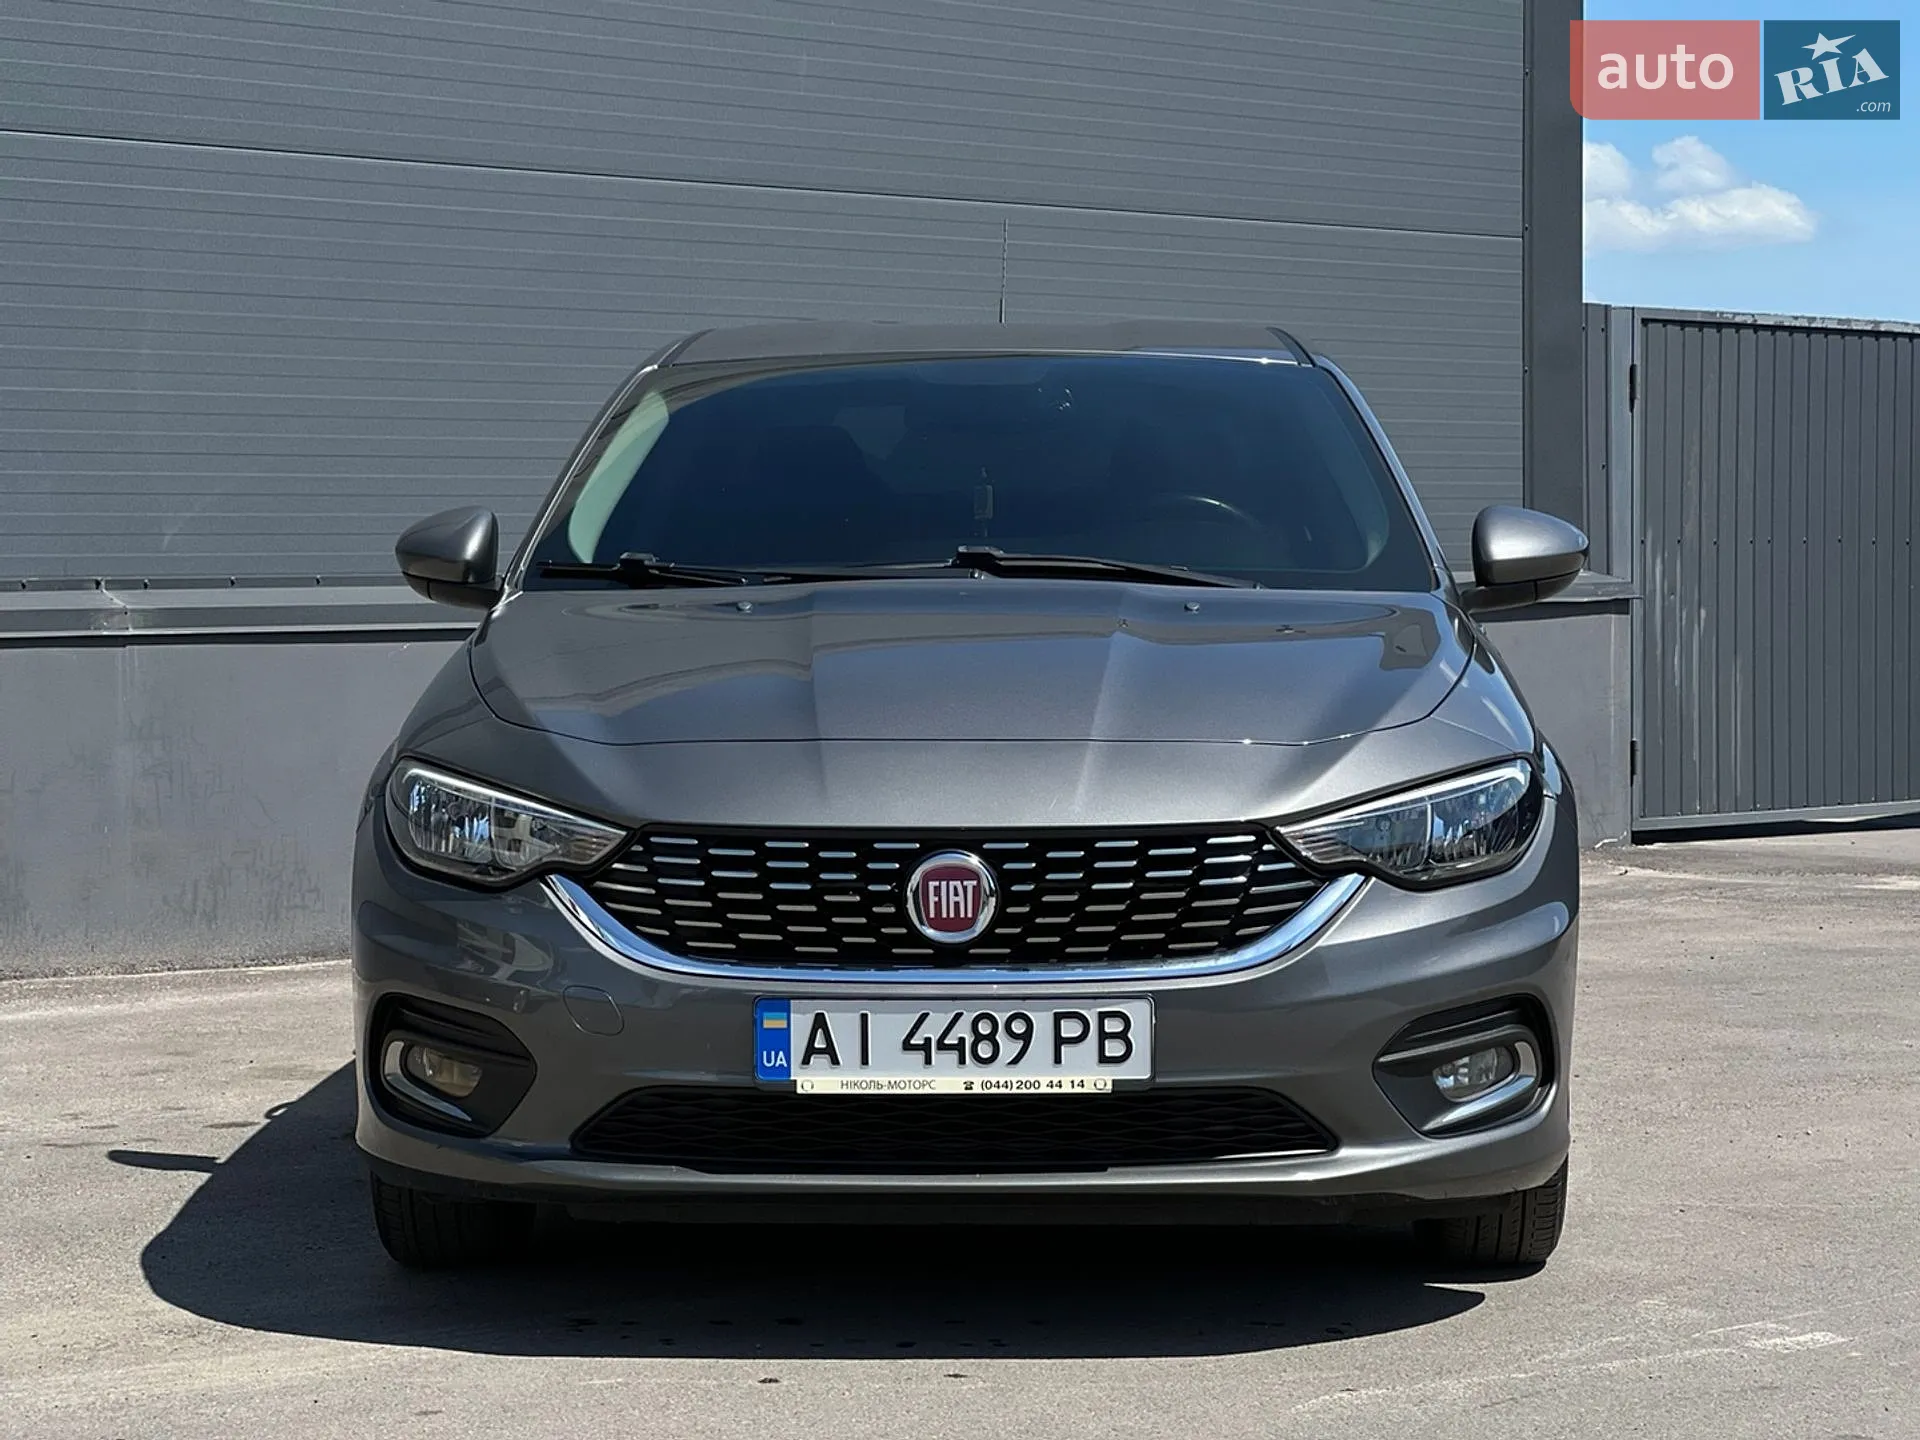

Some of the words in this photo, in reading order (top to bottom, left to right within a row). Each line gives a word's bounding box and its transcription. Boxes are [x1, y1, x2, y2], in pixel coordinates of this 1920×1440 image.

[928, 880, 977, 919] FIAT
[902, 1011, 1034, 1066] 4489
[1053, 1010, 1133, 1065] PB
[763, 1050, 787, 1068] UA
[840, 1079, 936, 1091] НІКОЛЬ-МОТОРС
[980, 1079, 1014, 1091] (044)
[1015, 1079, 1041, 1090] 200
[1046, 1079, 1063, 1090] 44
[1070, 1079, 1085, 1090] 14
